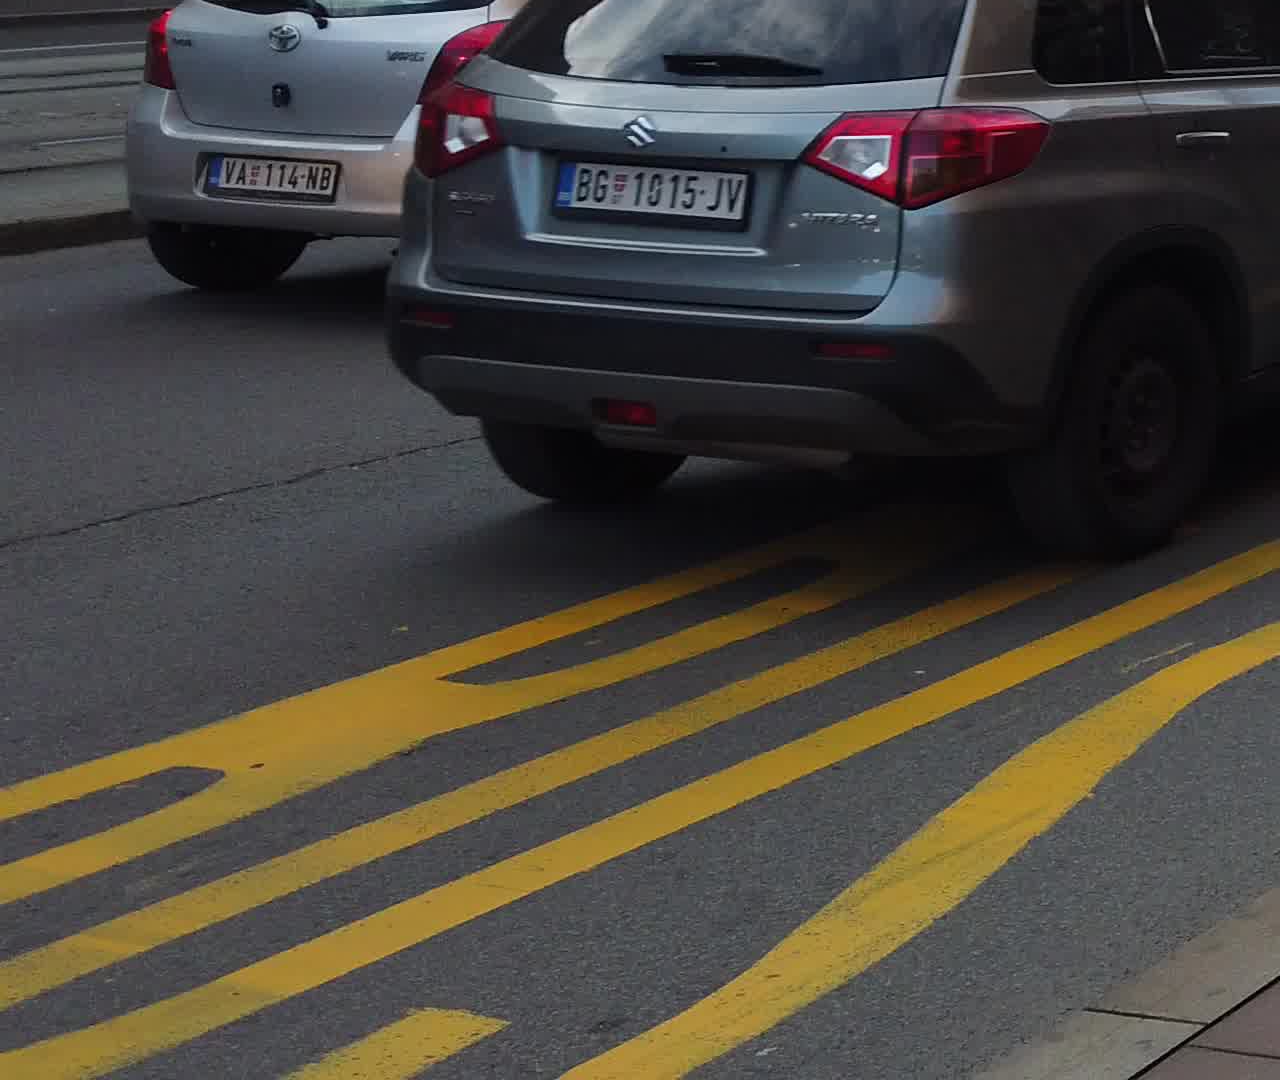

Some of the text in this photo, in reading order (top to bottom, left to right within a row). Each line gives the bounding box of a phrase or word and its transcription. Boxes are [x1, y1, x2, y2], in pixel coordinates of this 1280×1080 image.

[223, 160, 333, 191] VA 114-NB
[576, 167, 609, 203] BG
